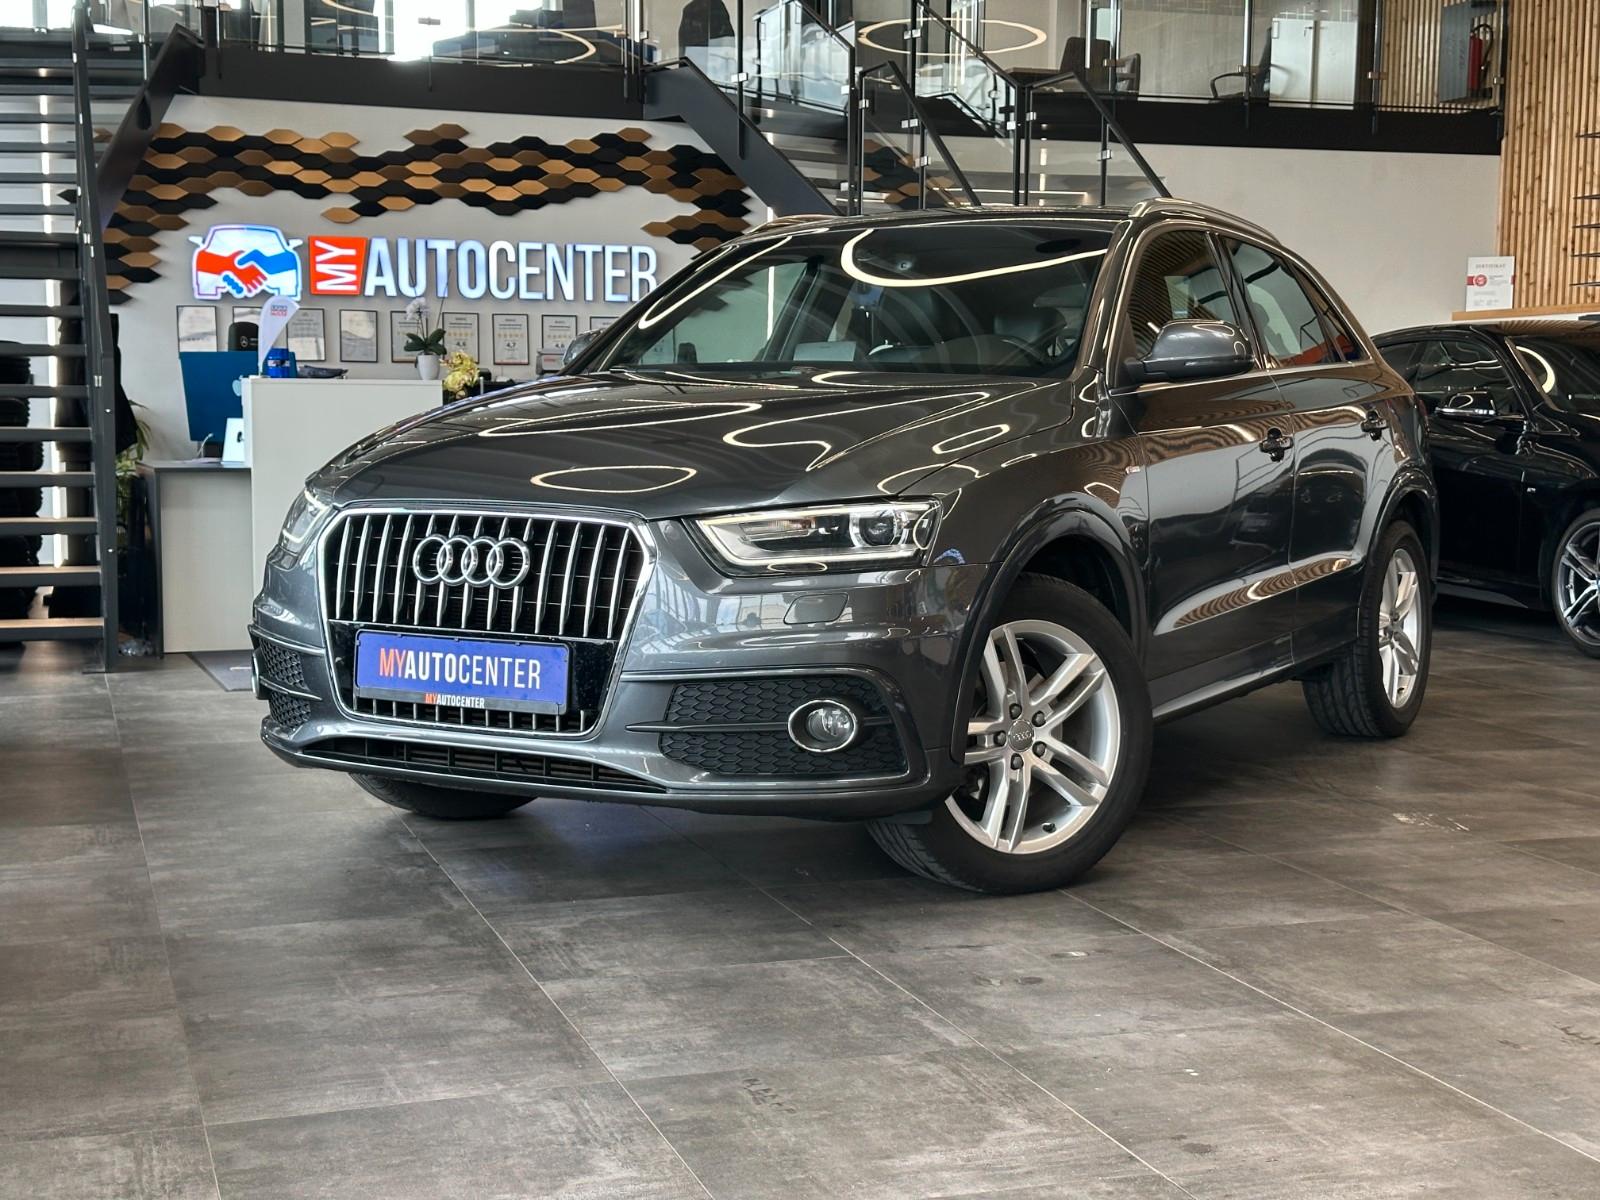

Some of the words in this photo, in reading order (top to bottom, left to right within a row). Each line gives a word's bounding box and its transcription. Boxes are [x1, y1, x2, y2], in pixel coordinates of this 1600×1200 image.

[314, 240, 357, 292] MY
[364, 237, 658, 303] AUTOCENTER
[379, 648, 540, 689] MYAUTOCENTER
[424, 692, 485, 709] MYAUTOCENTER
